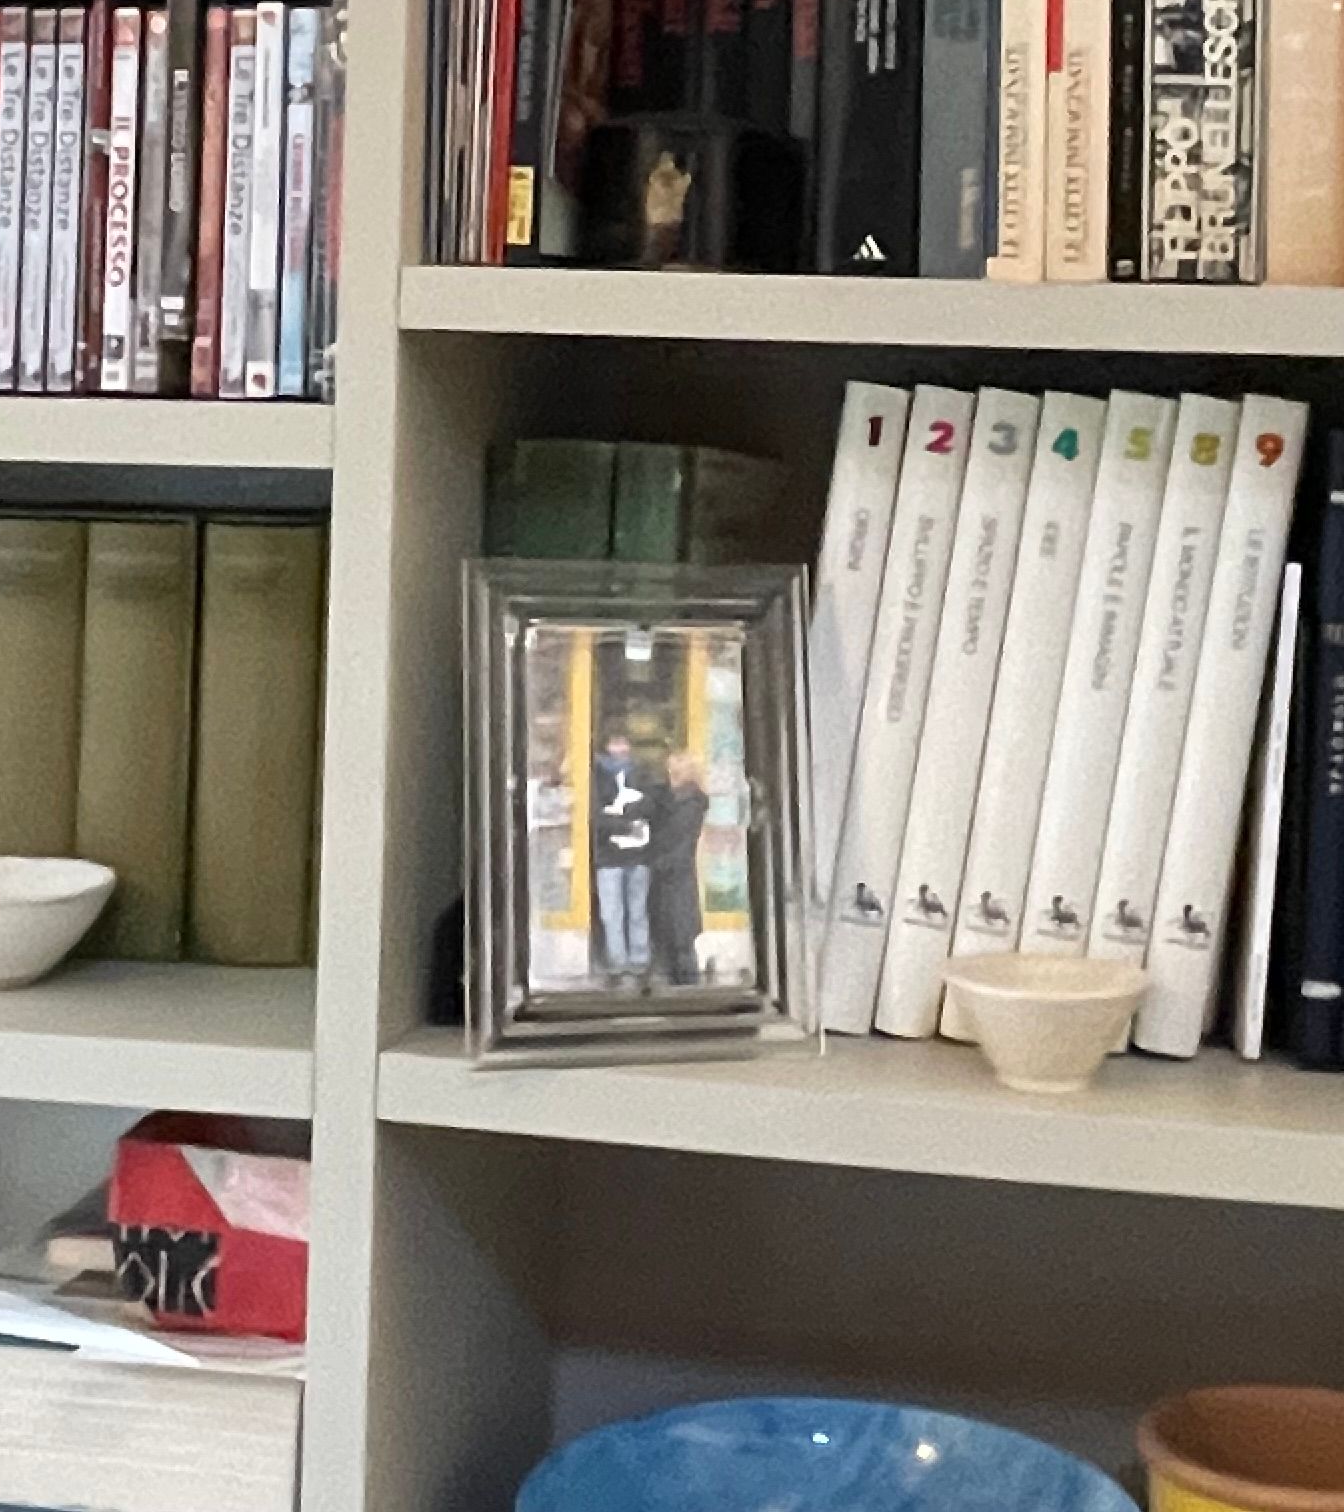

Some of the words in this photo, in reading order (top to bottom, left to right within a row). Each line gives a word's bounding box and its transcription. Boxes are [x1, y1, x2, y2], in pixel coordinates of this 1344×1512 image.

[2, 49, 22, 76] Le
[32, 52, 54, 77] Le
[61, 52, 82, 77] Le
[233, 52, 254, 80] Le
[1, 79, 21, 121] Tre
[31, 82, 52, 121] Tre
[60, 82, 81, 121] Tre
[232, 85, 252, 125] Tre
[114, 116, 132, 143] IL
[28, 129, 50, 232] Distanze
[57, 129, 79, 232] Distanze
[227, 132, 250, 236] Distanze
[107, 148, 130, 289] PROCESSO
[866, 415, 884, 449] 1
[926, 420, 957, 454] 2
[988, 421, 1019, 458] 3
[1050, 427, 1081, 463] 4
[1125, 427, 1156, 463] 5
[1190, 431, 1222, 466] 8
[1254, 431, 1285, 468] 9
